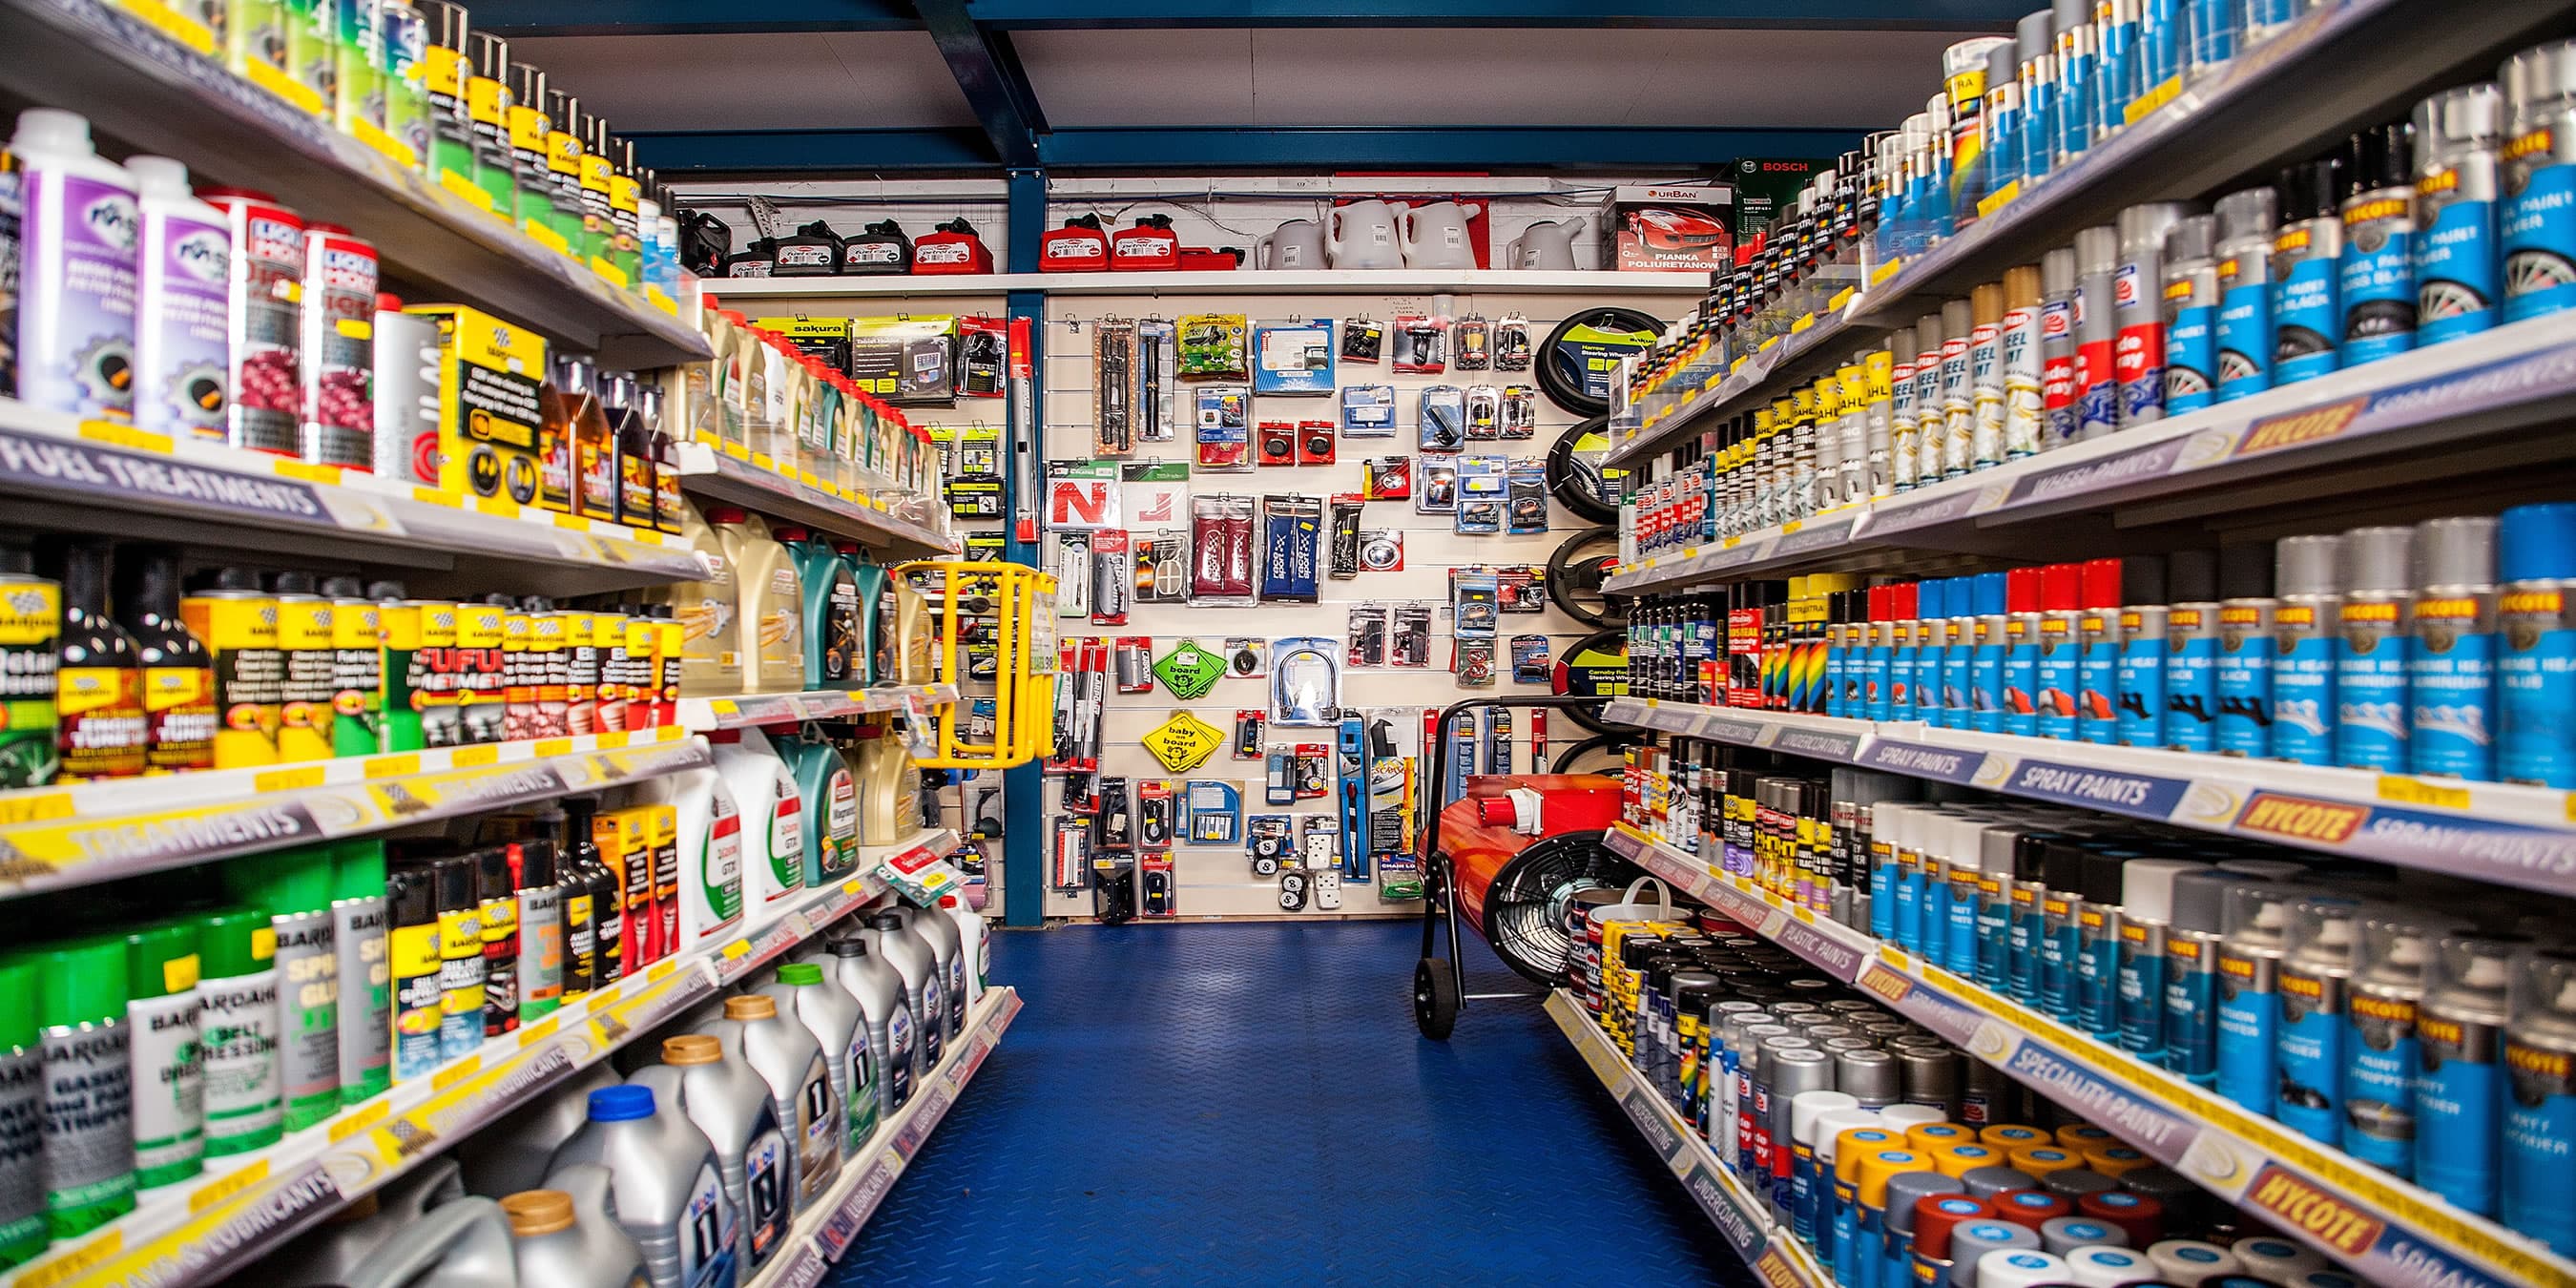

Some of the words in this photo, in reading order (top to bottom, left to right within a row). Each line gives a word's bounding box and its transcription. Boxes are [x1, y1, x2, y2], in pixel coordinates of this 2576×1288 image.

[2503, 132, 2553, 158] COTE
[1763, 162, 1809, 172] BOSCH
[1835, 185, 1855, 197] XTRA
[1815, 201, 1835, 215] XTRA
[1797, 218, 1816, 230] XTRA
[1779, 232, 1798, 244] XTRA
[1628, 260, 1719, 270] POLIURETANOW
[1654, 253, 1700, 261] PIANKA
[1734, 271, 1752, 281] XTRA
[794, 324, 841, 334] sakura
[1581, 349, 1609, 358] Steering
[2251, 407, 2355, 448] HYCOTE
[2, 438, 108, 484] FUEL
[96, 453, 318, 516] TREATMENTS
[1053, 482, 1108, 524] N
[1170, 666, 1201, 675] board
[1163, 737, 1196, 748] board
[1168, 726, 1195, 737] baby
[1876, 746, 1912, 767] SPRAY
[1911, 750, 1963, 777] PAINTS
[2020, 766, 2077, 799] SPRAY
[2075, 776, 2151, 807] PAINTS
[2244, 797, 2357, 841] HYCOTE
[784, 837, 799, 850] GTX
[721, 861, 737, 876] GTX
[1737, 900, 1764, 925] PAINTS
[1783, 924, 1817, 953] PLASTIC
[1817, 942, 1854, 970] PAINTS
[1863, 967, 1908, 1001] HYCOTE
[810, 1081, 823, 1118] 1
[1628, 1096, 1672, 1152] UNDERCOATING
[2107, 1097, 2180, 1146] PAINT
[747, 1143, 775, 1179] Mobil
[690, 1183, 717, 1218] Mobil
[1693, 1174, 1755, 1250] UNDERCOATING
[2257, 1173, 2369, 1250] HYCOTE
[698, 1213, 715, 1259] 1
